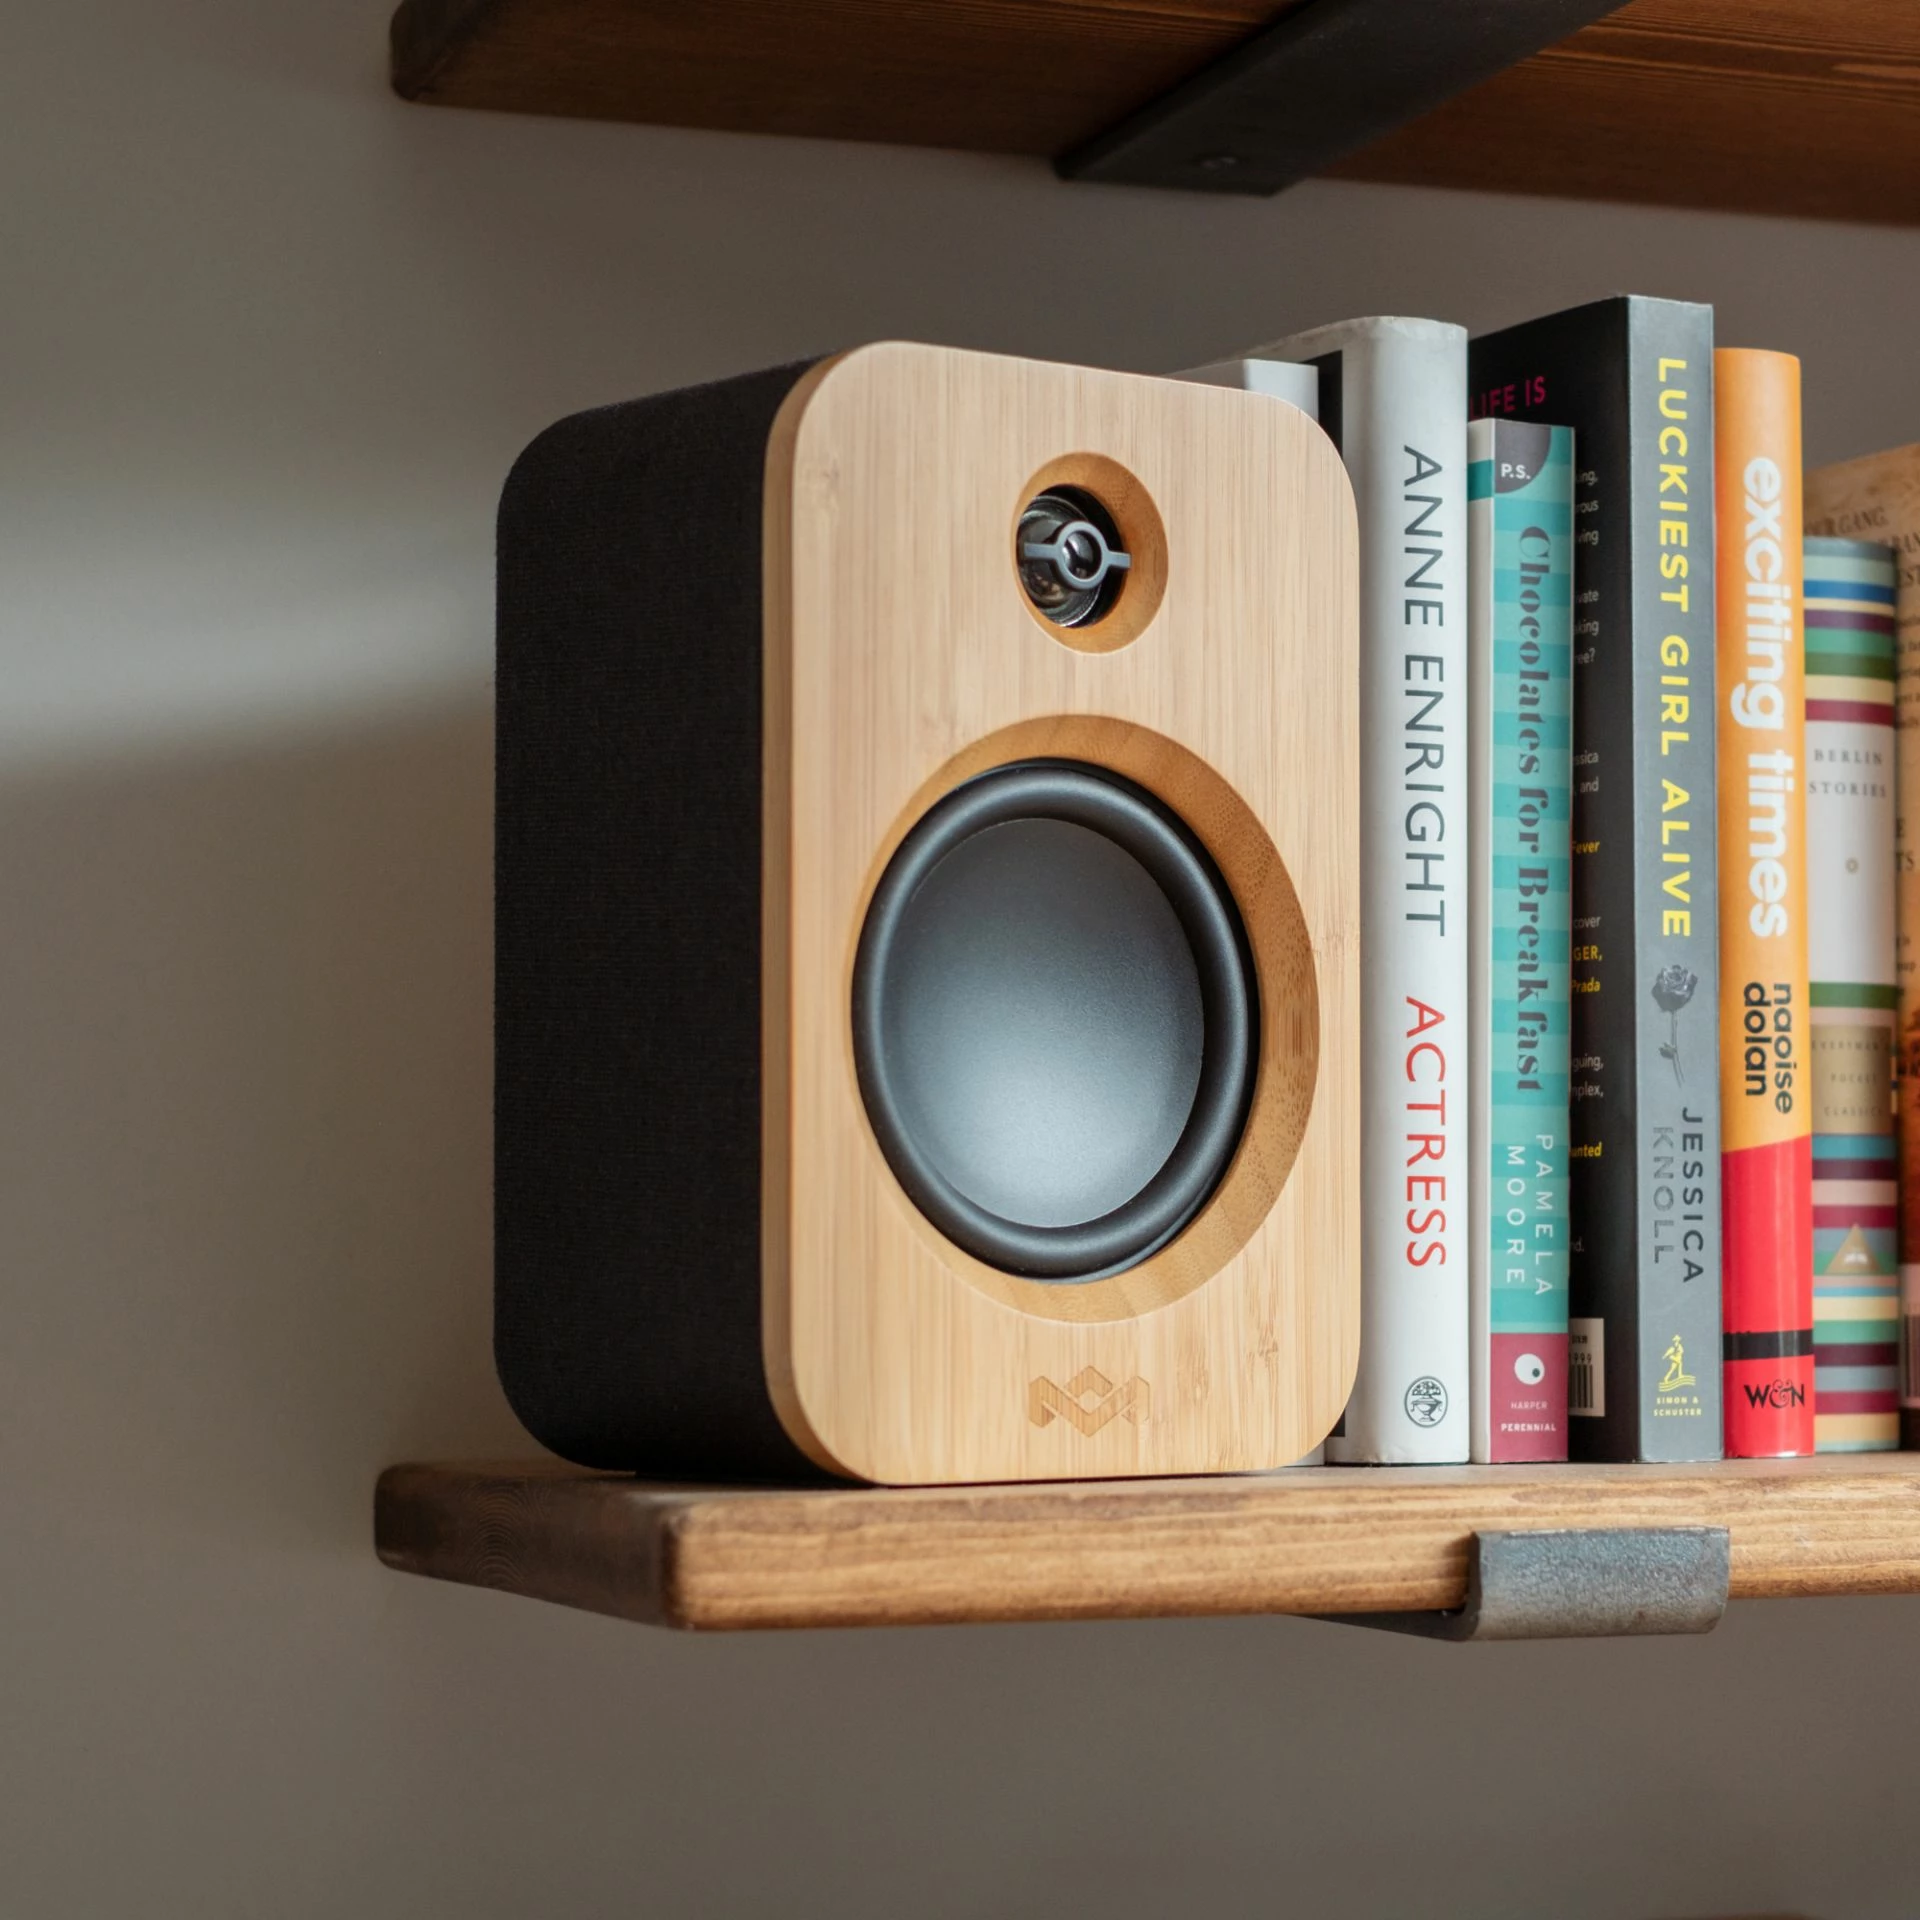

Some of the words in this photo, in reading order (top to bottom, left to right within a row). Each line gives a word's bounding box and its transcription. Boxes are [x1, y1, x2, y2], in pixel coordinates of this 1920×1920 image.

[1525, 376, 1547, 407] IS
[1403, 444, 1444, 627] ANNE
[1500, 463, 1531, 480] P.S.
[1658, 357, 1689, 613] LUCKIEST
[1518, 526, 1552, 776] Chocolates
[1730, 456, 1793, 731] exciting
[1660, 634, 1690, 756] GIRL
[1813, 749, 1883, 765] BERLIN
[1404, 653, 1445, 937] ENRIGHT
[1518, 788, 1550, 855] for
[1748, 748, 1795, 939] times
[1808, 781, 1888, 798] STORIES
[1661, 779, 1691, 938] ALIVE
[1517, 866, 1550, 1091] Breakfast
[1743, 981, 1773, 1097] dolan
[1773, 982, 1797, 1115] naoise
[1404, 996, 1447, 1269] ACTRESS
[1653, 1126, 1675, 1264] KNOLL
[1682, 1107, 1704, 1283] JESSICA
[1506, 1146, 1526, 1284] MOORE
[1535, 1134, 1553, 1296] PAMELA
[1500, 1422, 1557, 1432] PERENNIAL
[1510, 1401, 1549, 1410] HARPER
[1653, 1407, 1702, 1417] SCHUSTER
[1656, 1395, 1688, 1405] SIMON
[1743, 1379, 1805, 1409] W&N
